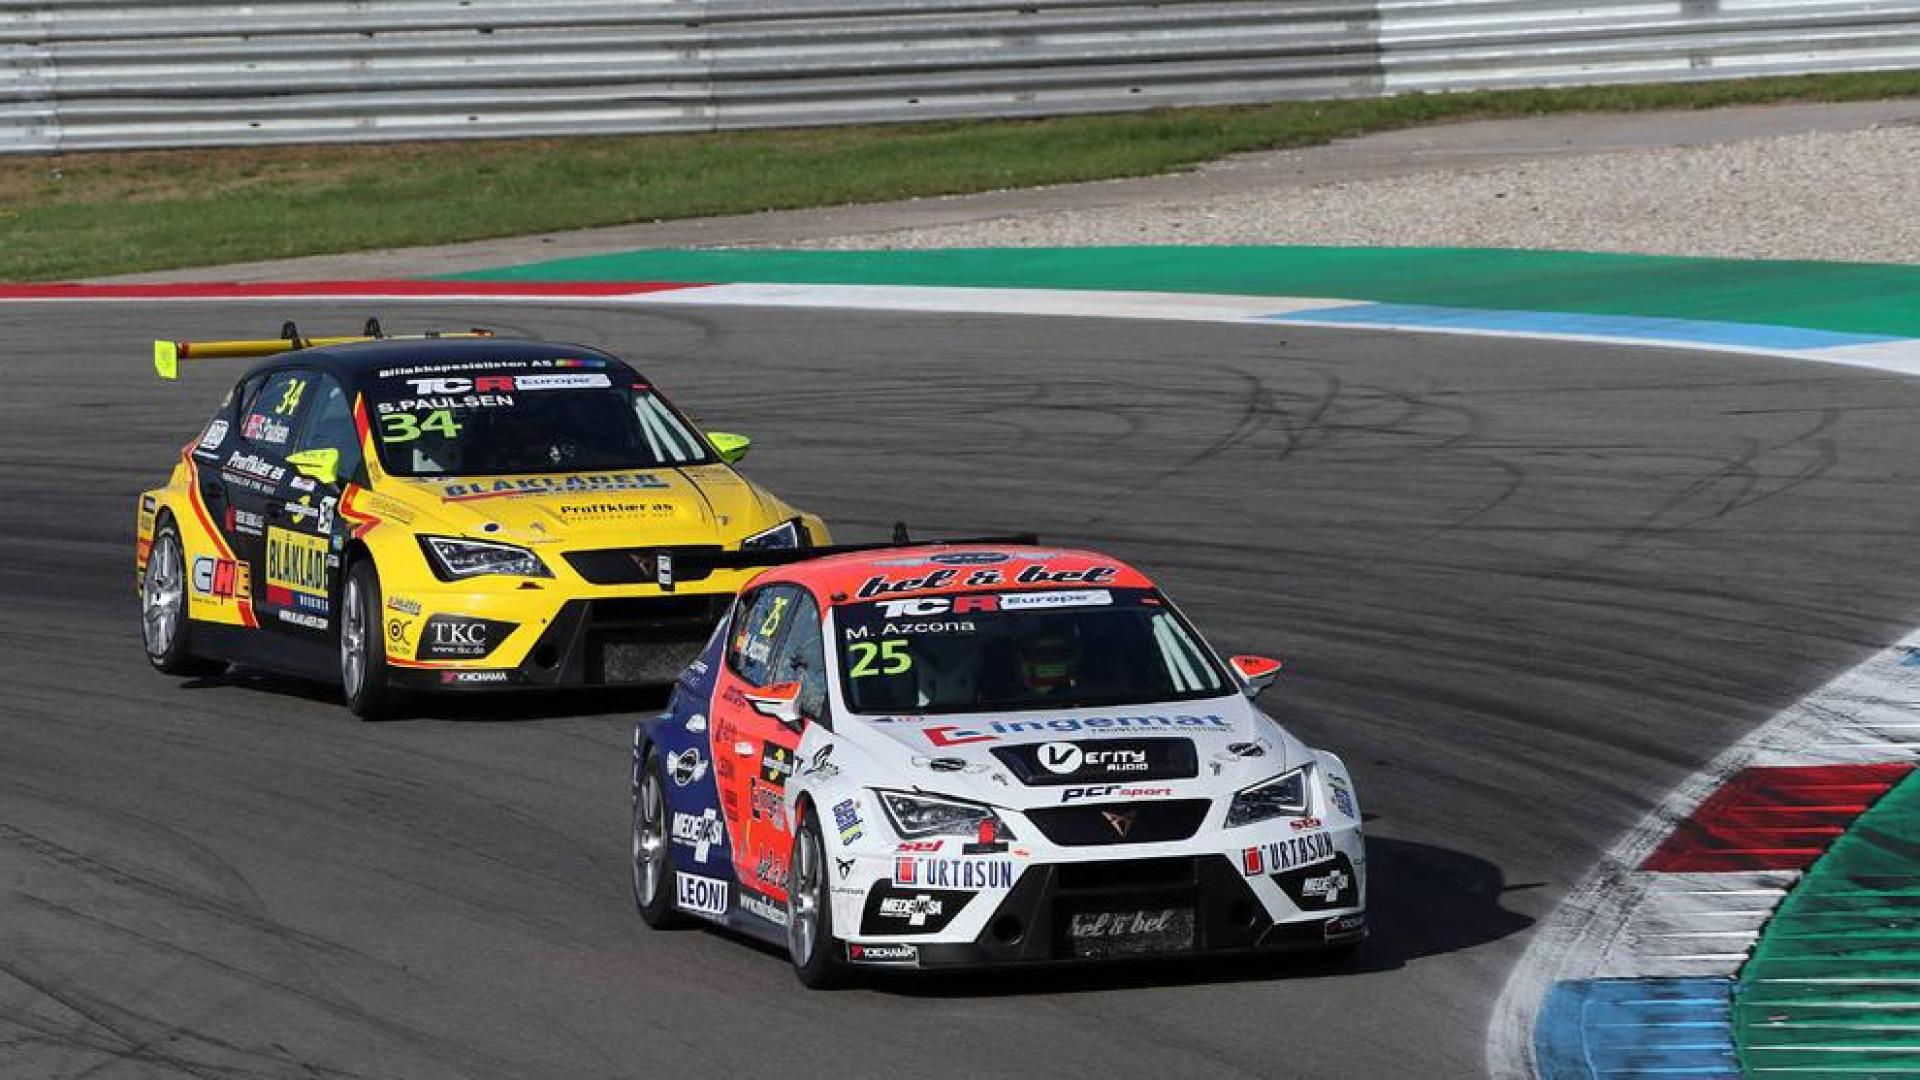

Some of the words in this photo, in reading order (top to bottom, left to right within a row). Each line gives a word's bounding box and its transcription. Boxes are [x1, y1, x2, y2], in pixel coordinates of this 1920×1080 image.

[407, 374, 515, 395] TCR
[274, 377, 307, 416] 34
[378, 394, 515, 413] S.PAULSEN
[380, 410, 464, 443] 34
[856, 567, 959, 600] bel
[1014, 564, 1118, 584] bel
[876, 593, 1001, 617] TCR
[1007, 593, 1087, 604] Europe
[431, 622, 487, 642] TKC
[845, 627, 876, 640] M.
[881, 619, 976, 636] Azcona
[849, 639, 913, 678] 25
[456, 671, 508, 683] YOKOHAMA
[988, 712, 1227, 735] ingemat
[926, 859, 1013, 889] URTASUN
